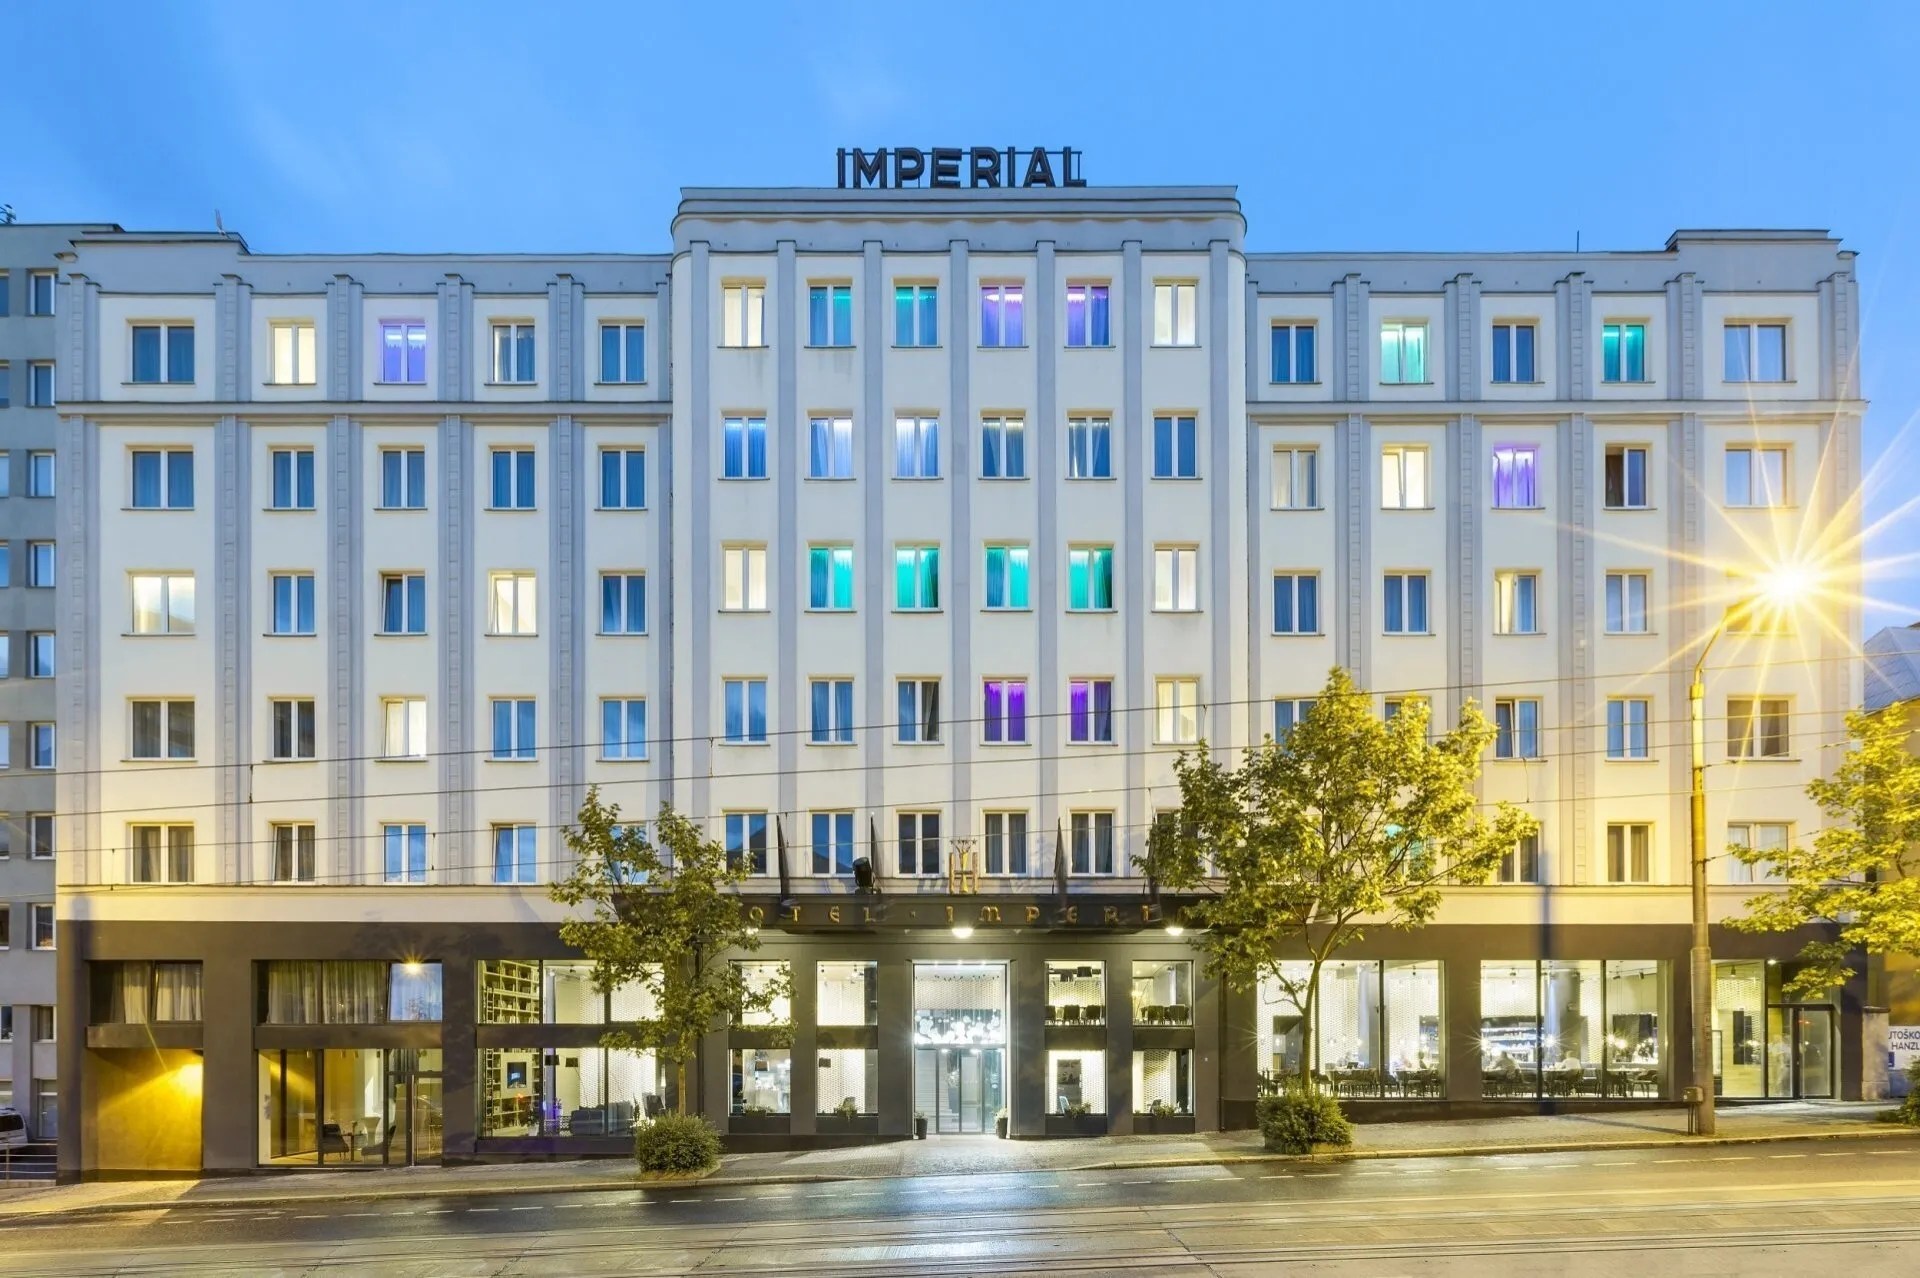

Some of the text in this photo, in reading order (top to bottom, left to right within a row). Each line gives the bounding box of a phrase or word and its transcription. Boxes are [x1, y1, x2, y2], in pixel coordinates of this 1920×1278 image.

[837, 146, 1087, 188] IMPERIAL
[750, 905, 1188, 923] OTEL IMPERI
